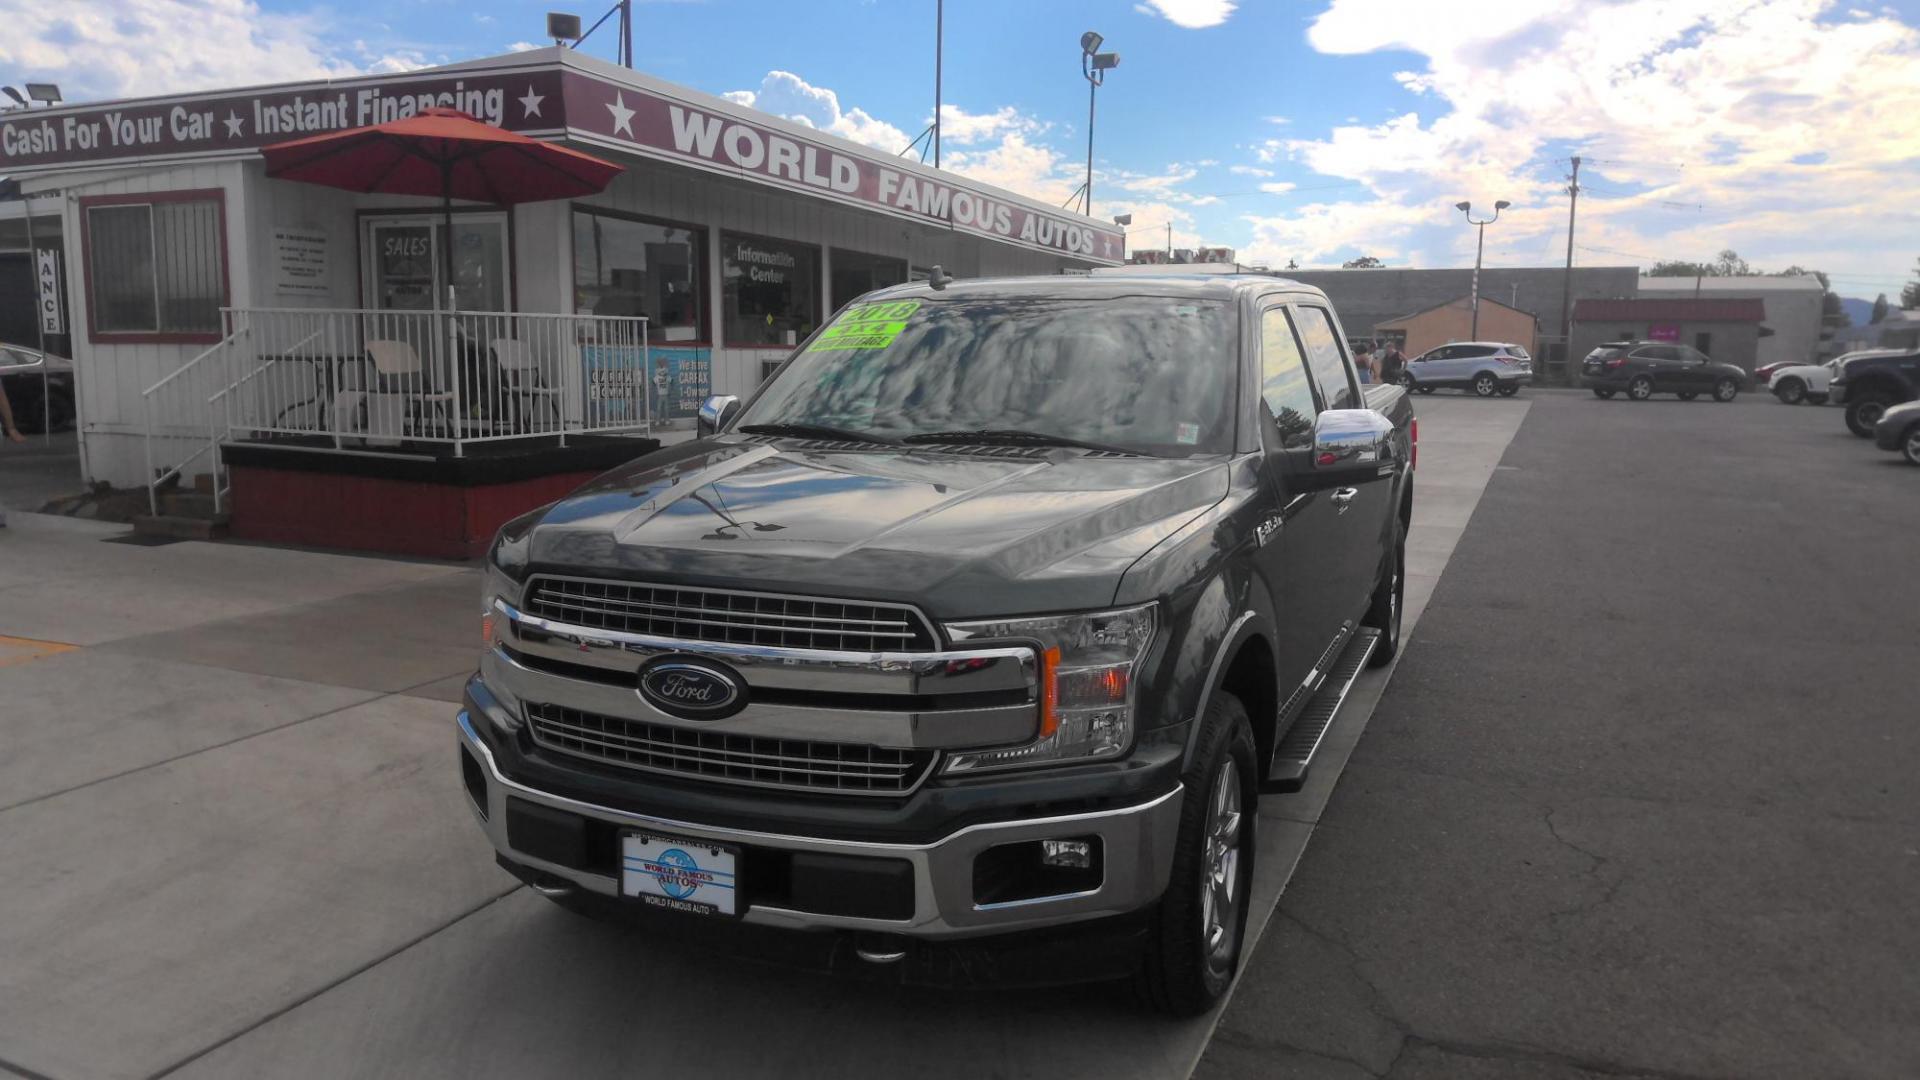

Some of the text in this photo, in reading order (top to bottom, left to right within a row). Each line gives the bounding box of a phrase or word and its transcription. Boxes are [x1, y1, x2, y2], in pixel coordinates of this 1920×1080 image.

[254, 93, 349, 135] Instant
[2, 106, 214, 156] Cash For Your Car
[669, 105, 1095, 255] WORLD FAMOUS AUTOS
[384, 237, 428, 256] SALES
[737, 244, 796, 268] Information
[750, 265, 784, 284] Center
[661, 674, 713, 701] Ford
[644, 863, 714, 881] WORLD FAMOUS
[659, 874, 698, 888] AUTOS
[644, 896, 712, 915] WORLD FAMOUS AUTO
